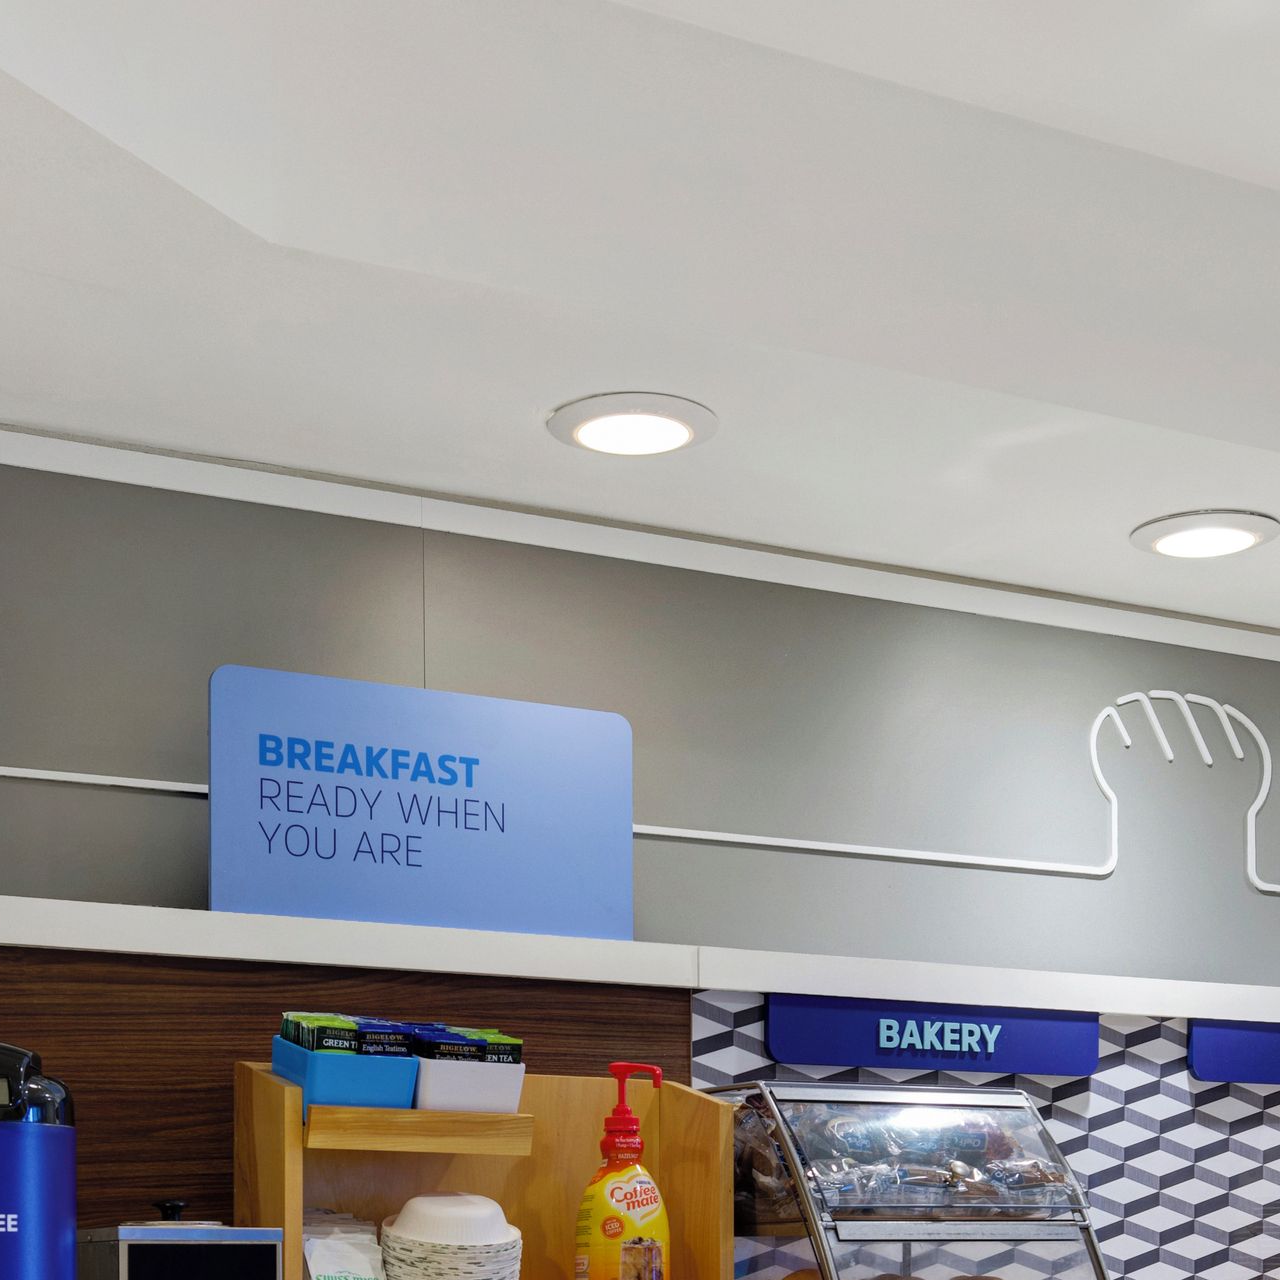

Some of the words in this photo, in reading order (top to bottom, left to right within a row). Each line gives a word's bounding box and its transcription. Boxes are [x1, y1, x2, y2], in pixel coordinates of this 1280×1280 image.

[258, 733, 480, 788] BREAKFAST
[259, 777, 383, 821] READY
[397, 792, 506, 834] WHEN
[258, 821, 337, 860] YOU
[353, 831, 423, 868] ARE
[322, 1038, 350, 1049] GREEN
[879, 1018, 1002, 1053] BAKERY
[499, 1054, 514, 1062] TEA
[610, 1185, 657, 1204] Coffee
[626, 1194, 659, 1211] mate
